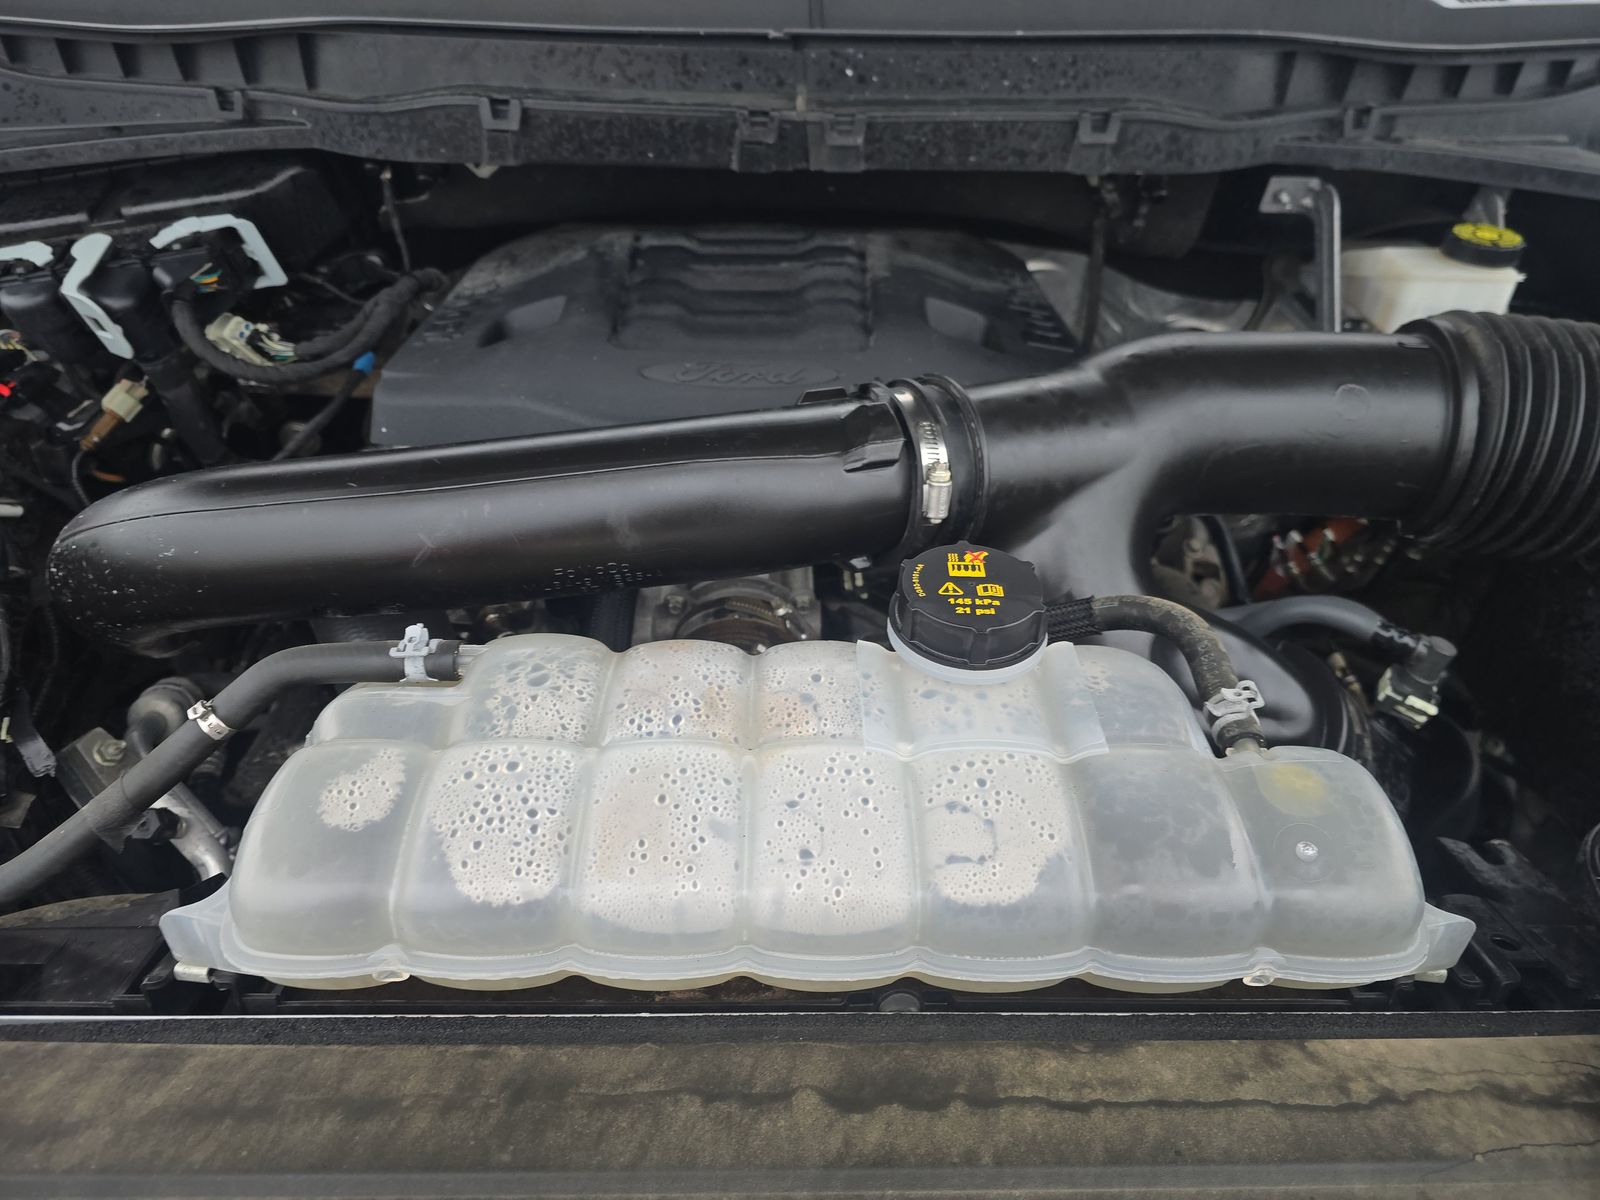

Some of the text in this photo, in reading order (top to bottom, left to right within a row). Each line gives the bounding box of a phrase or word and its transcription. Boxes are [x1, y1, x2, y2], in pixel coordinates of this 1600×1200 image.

[674, 361, 808, 385] Ford
[947, 597, 1001, 606] 145 kPa
[955, 606, 996, 616] 21 psi
